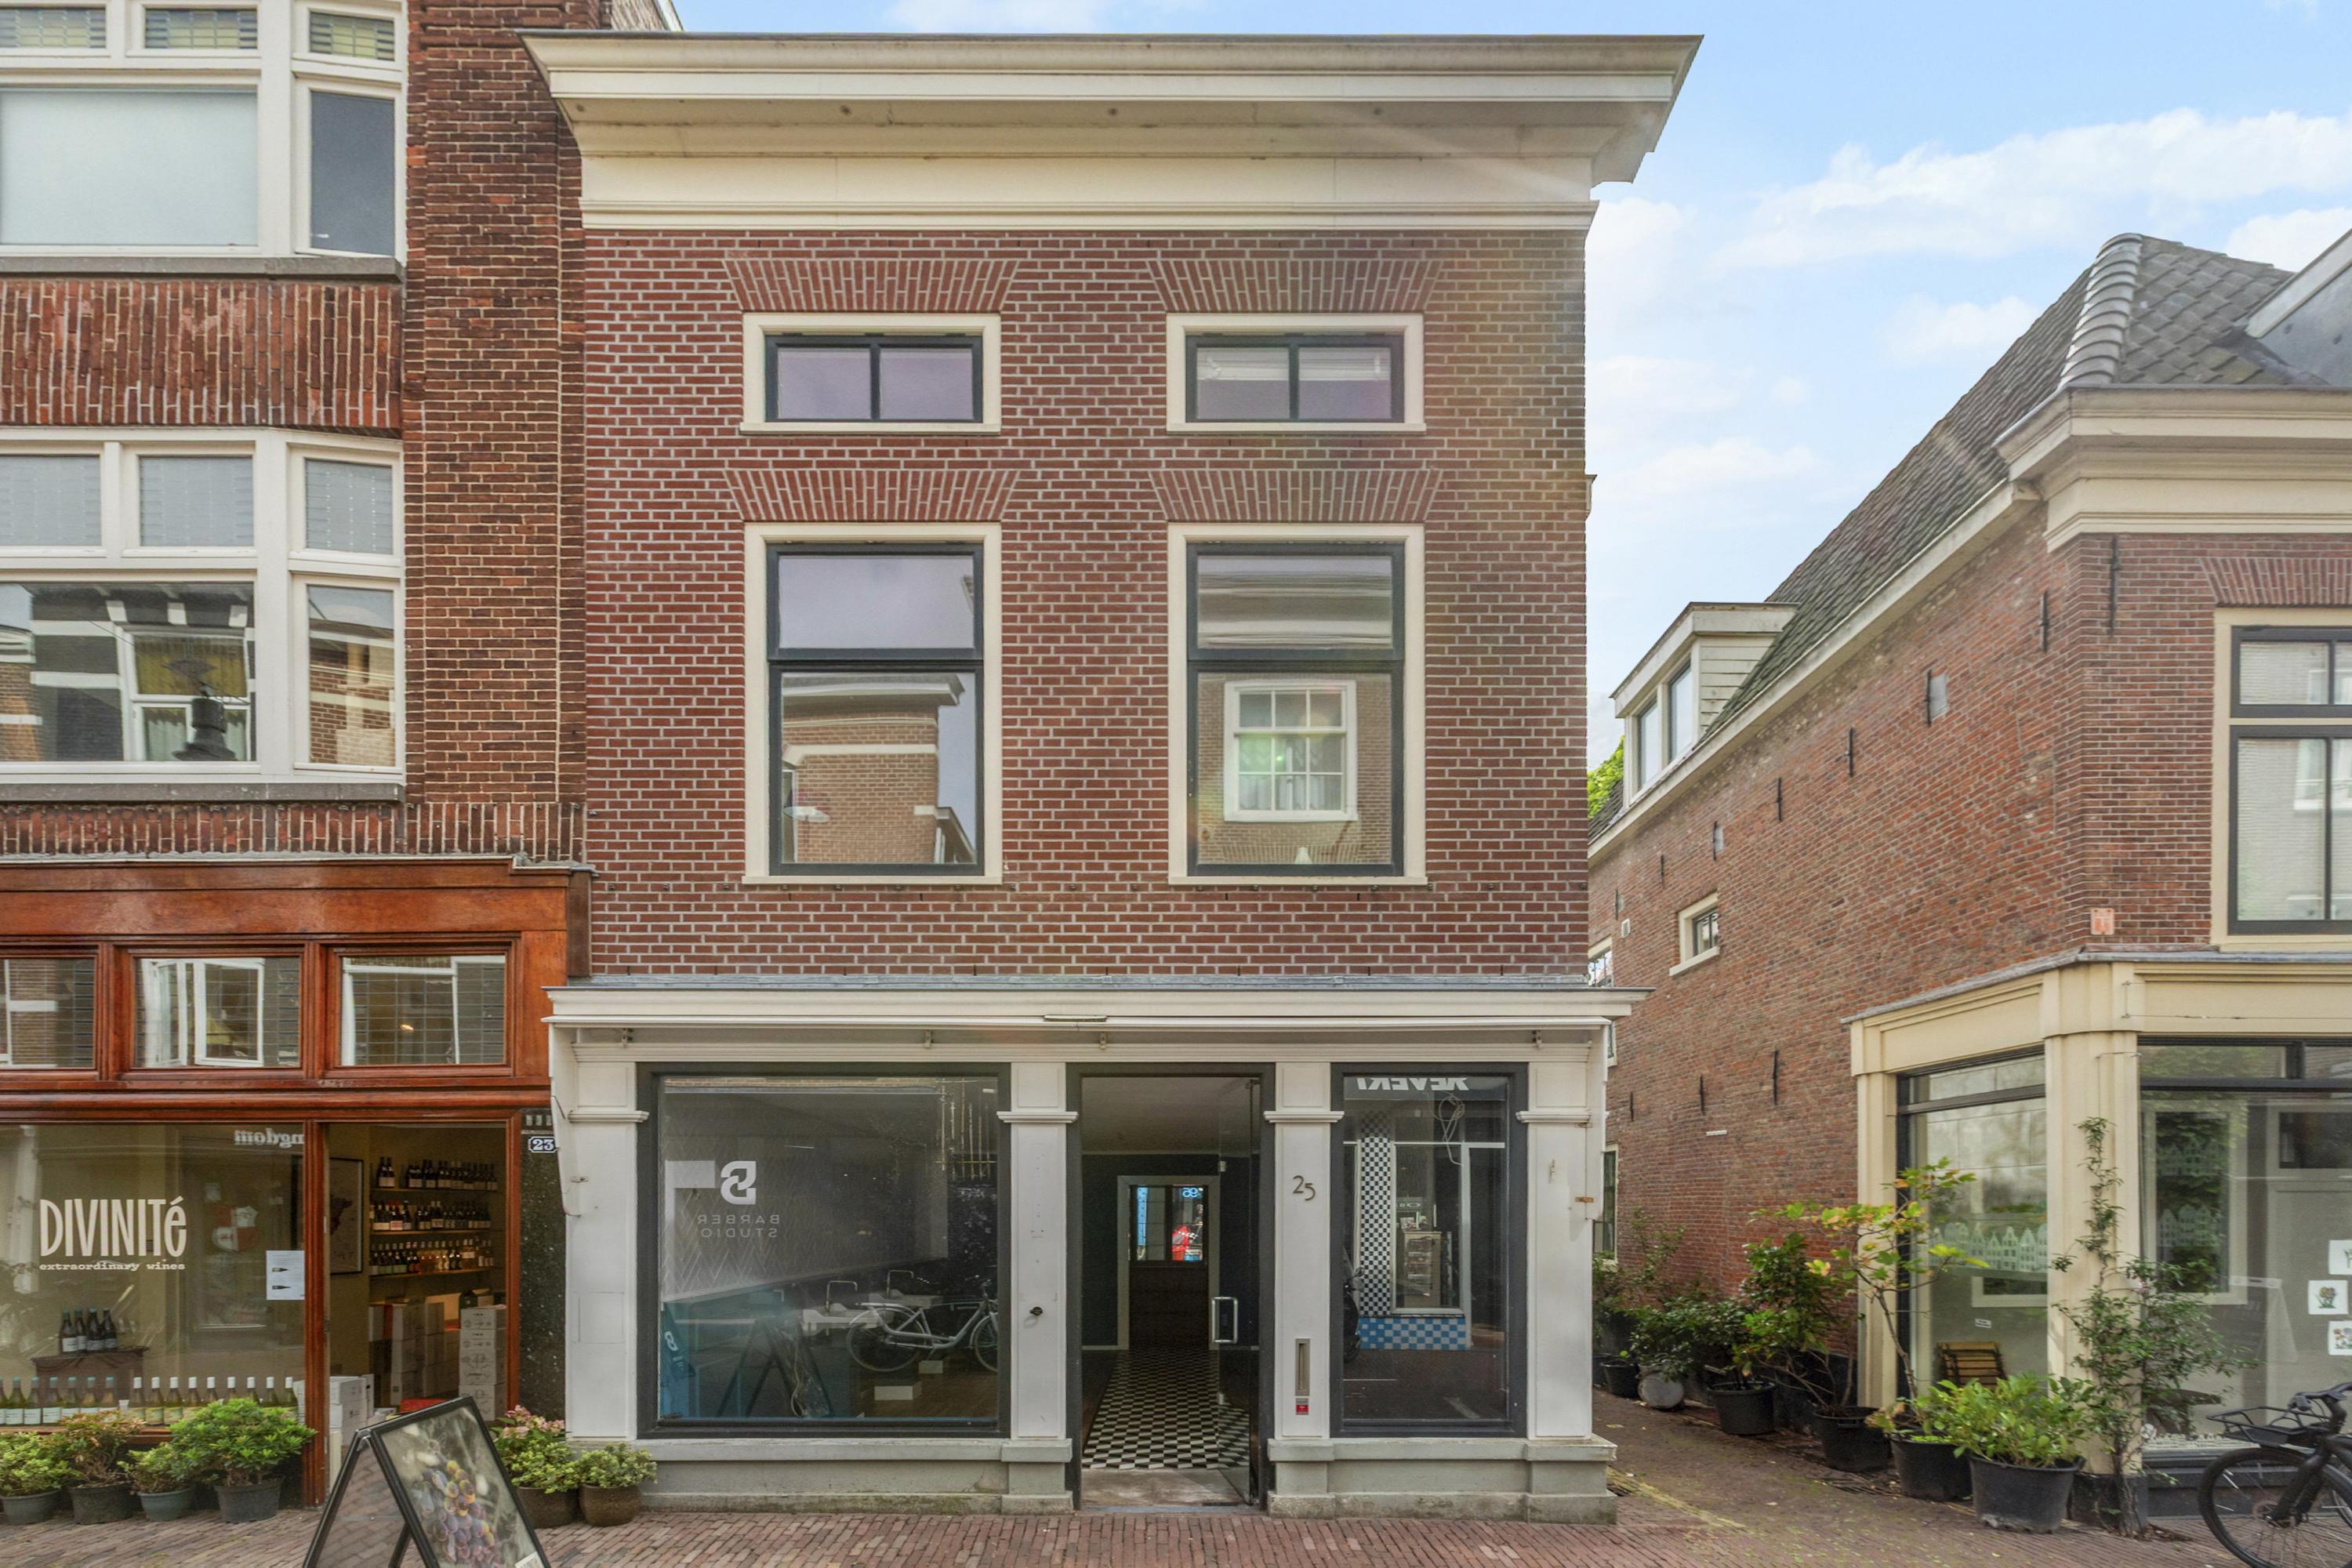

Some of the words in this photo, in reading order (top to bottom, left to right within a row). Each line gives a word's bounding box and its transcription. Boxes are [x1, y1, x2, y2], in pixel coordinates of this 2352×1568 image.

[532, 1138, 554, 1151] 23
[1293, 1175, 1316, 1201] 25
[40, 1196, 187, 1257] DIVINITé
[39, 1261, 140, 1272] extraordinary
[146, 1259, 186, 1270] wines
